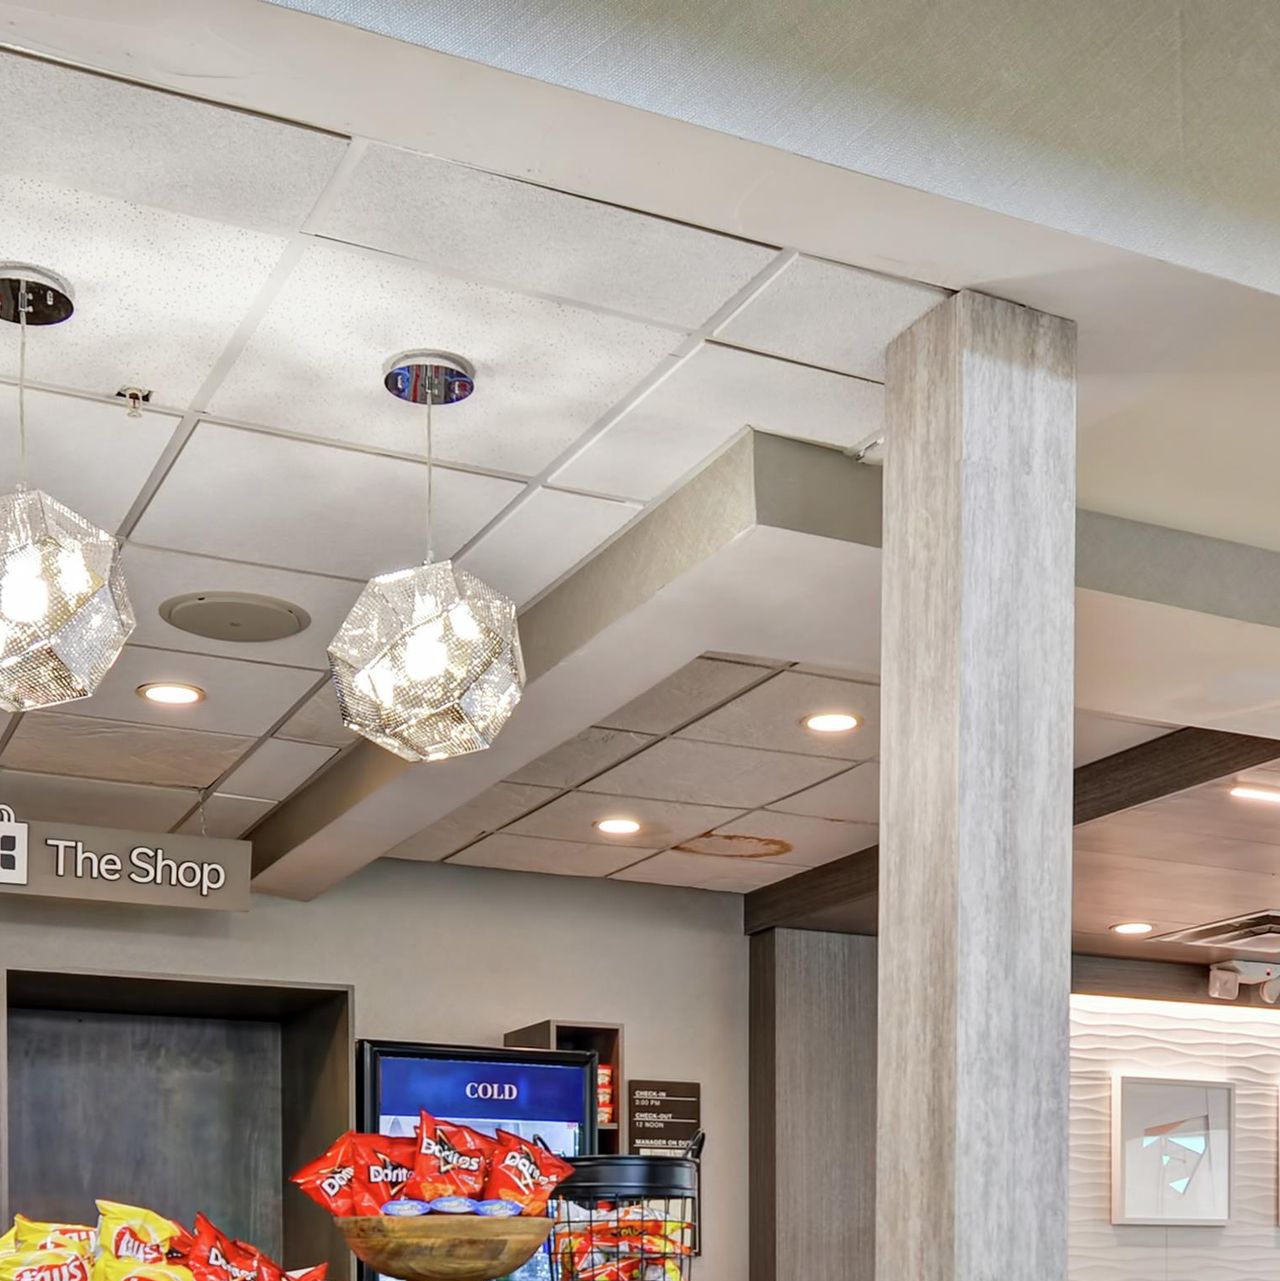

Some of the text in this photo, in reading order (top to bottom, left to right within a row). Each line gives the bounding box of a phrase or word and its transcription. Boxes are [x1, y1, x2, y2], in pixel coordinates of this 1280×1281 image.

[45, 839, 226, 896] The Shop
[465, 1082, 517, 1100] COLD
[634, 1090, 667, 1098] CHECK-IN
[634, 1112, 673, 1120] CHECK-OUT
[644, 1121, 665, 1129] NOON
[634, 1138, 667, 1146] MANAGER
